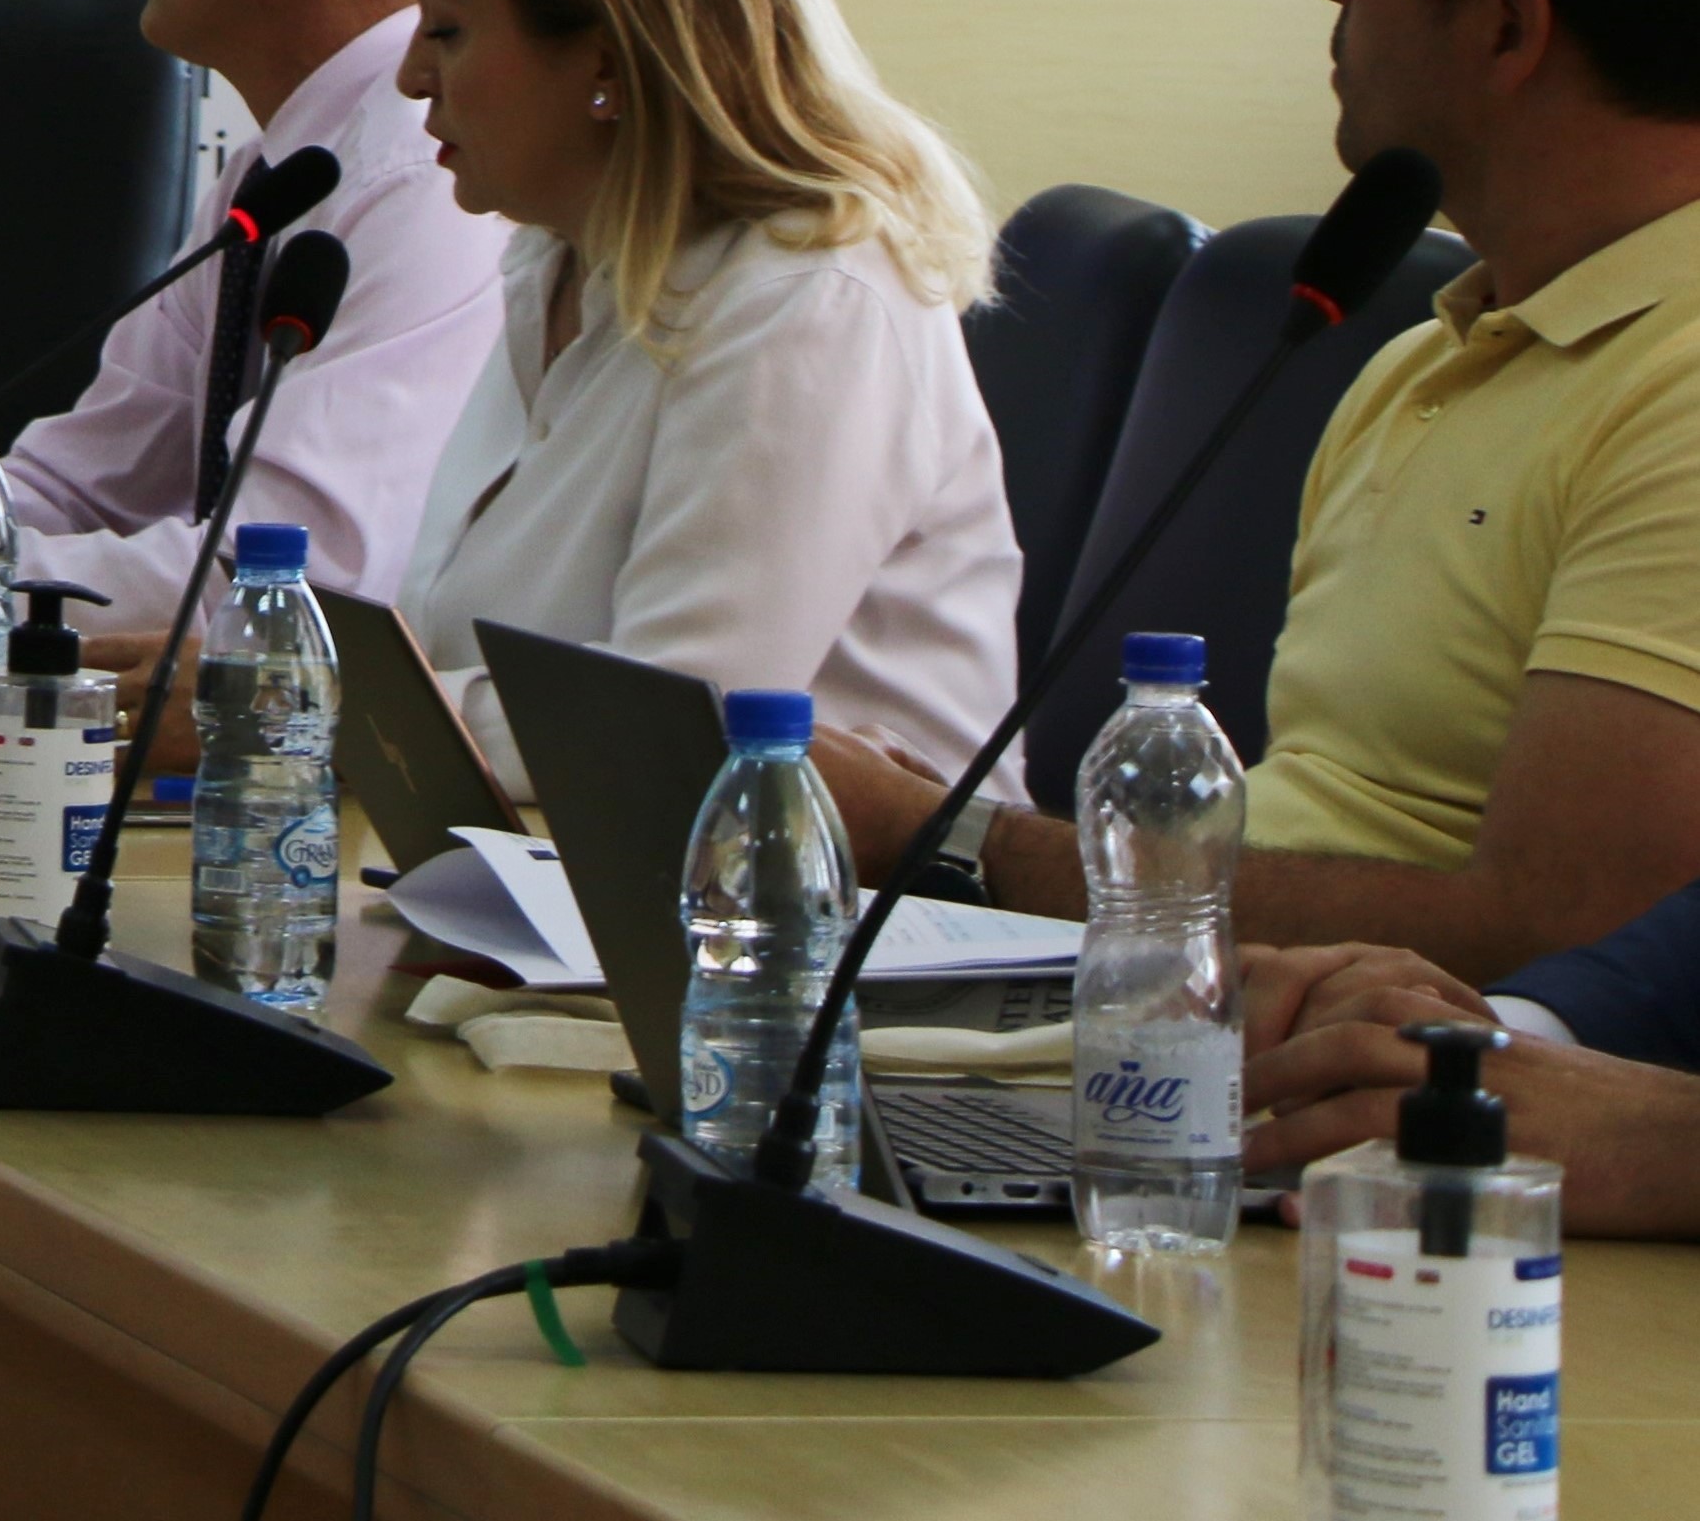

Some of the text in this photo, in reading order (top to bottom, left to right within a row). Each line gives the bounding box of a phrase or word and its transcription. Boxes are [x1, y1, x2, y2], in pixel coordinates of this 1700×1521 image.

[70, 850, 92, 867] GE
[1496, 1387, 1551, 1413] Hand
[1496, 1440, 1538, 1466] GEL
